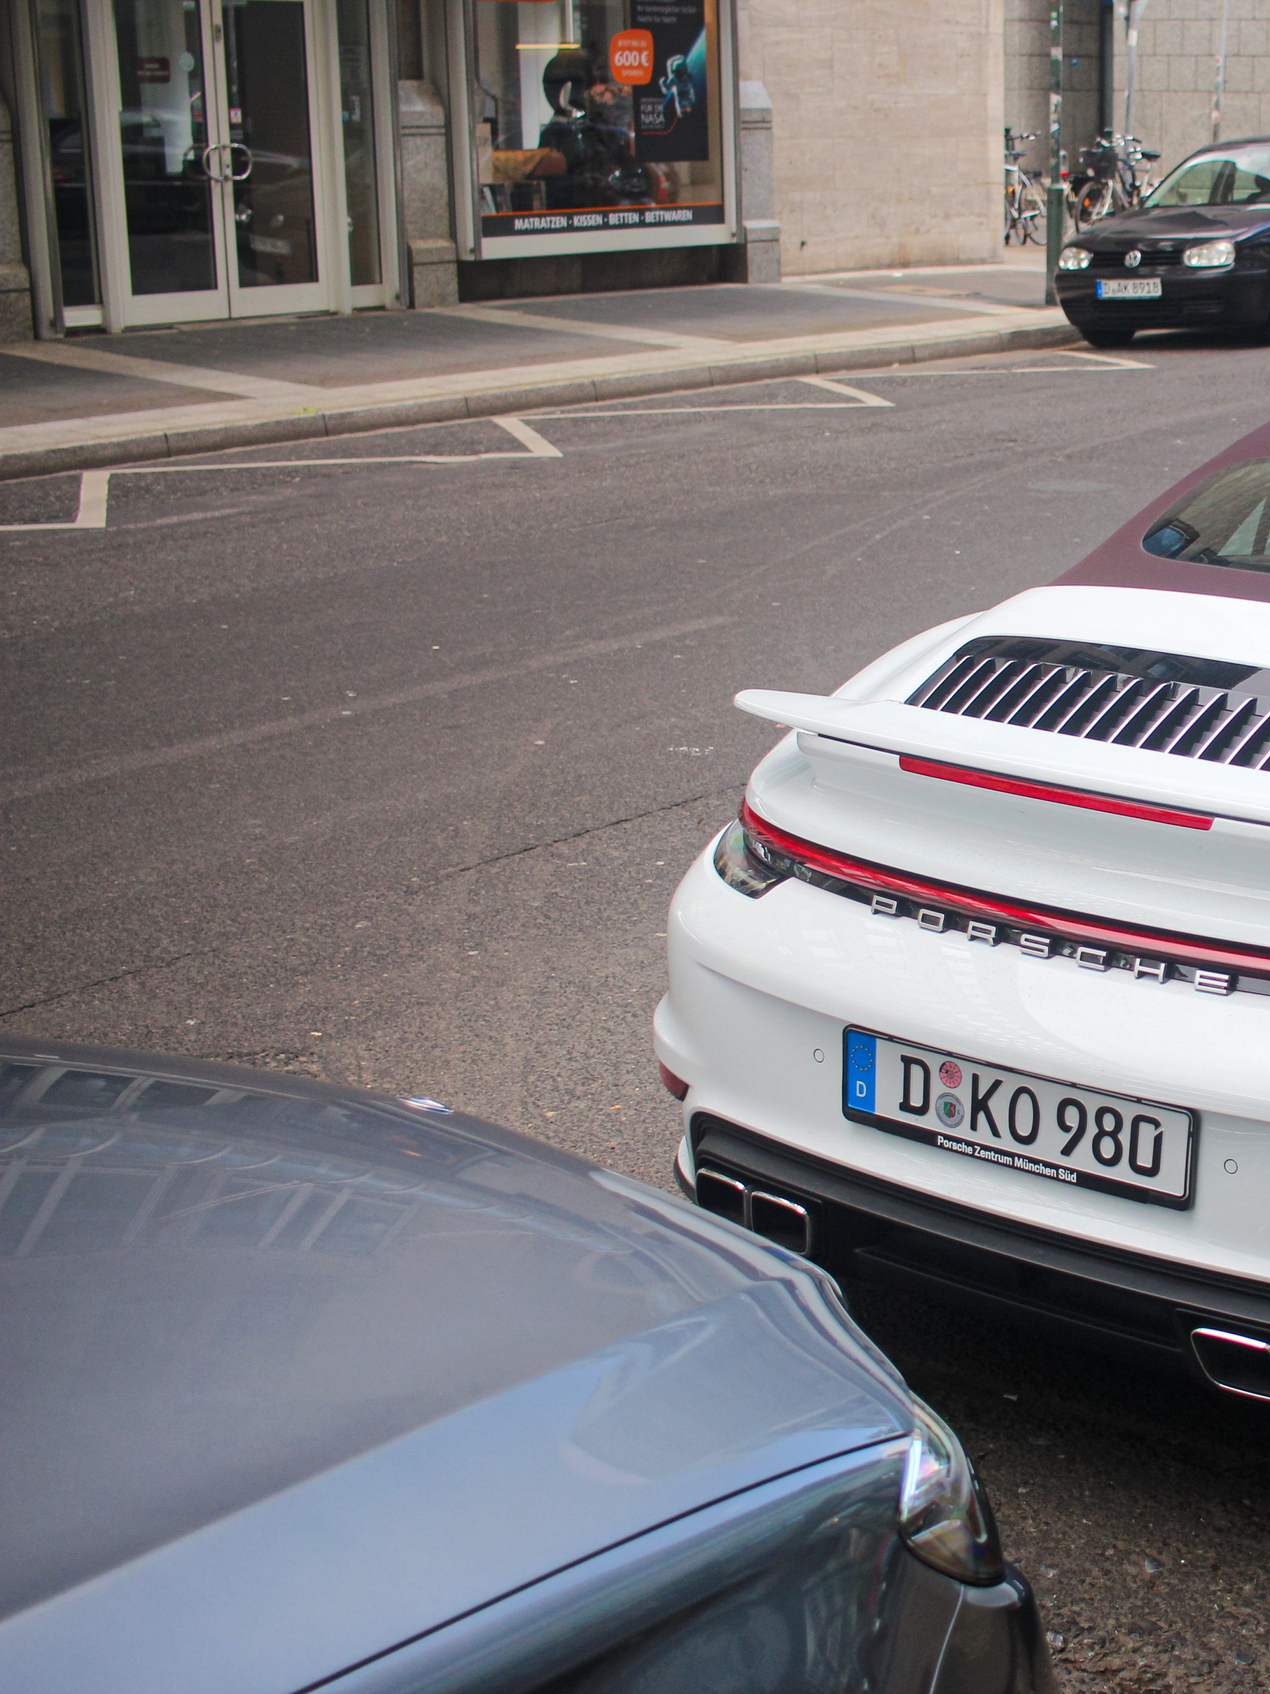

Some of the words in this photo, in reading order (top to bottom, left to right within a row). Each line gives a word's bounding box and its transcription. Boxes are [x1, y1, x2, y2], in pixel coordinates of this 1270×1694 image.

[514, 215, 568, 231] MATRATZEN
[573, 213, 603, 228] KISSEN
[608, 211, 640, 226] BETTEN
[644, 209, 693, 224] BETTWAREN
[871, 894, 1232, 995] PORSCHE
[856, 1080, 867, 1098] D
[899, 1054, 931, 1117] D
[970, 1072, 1041, 1146] KO
[1056, 1097, 1165, 1178] 980
[937, 1135, 973, 1155] Porsche
[974, 1145, 1013, 1167] Zentrum
[1014, 1156, 1057, 1178] München
[1058, 1168, 1077, 1183] Süd
